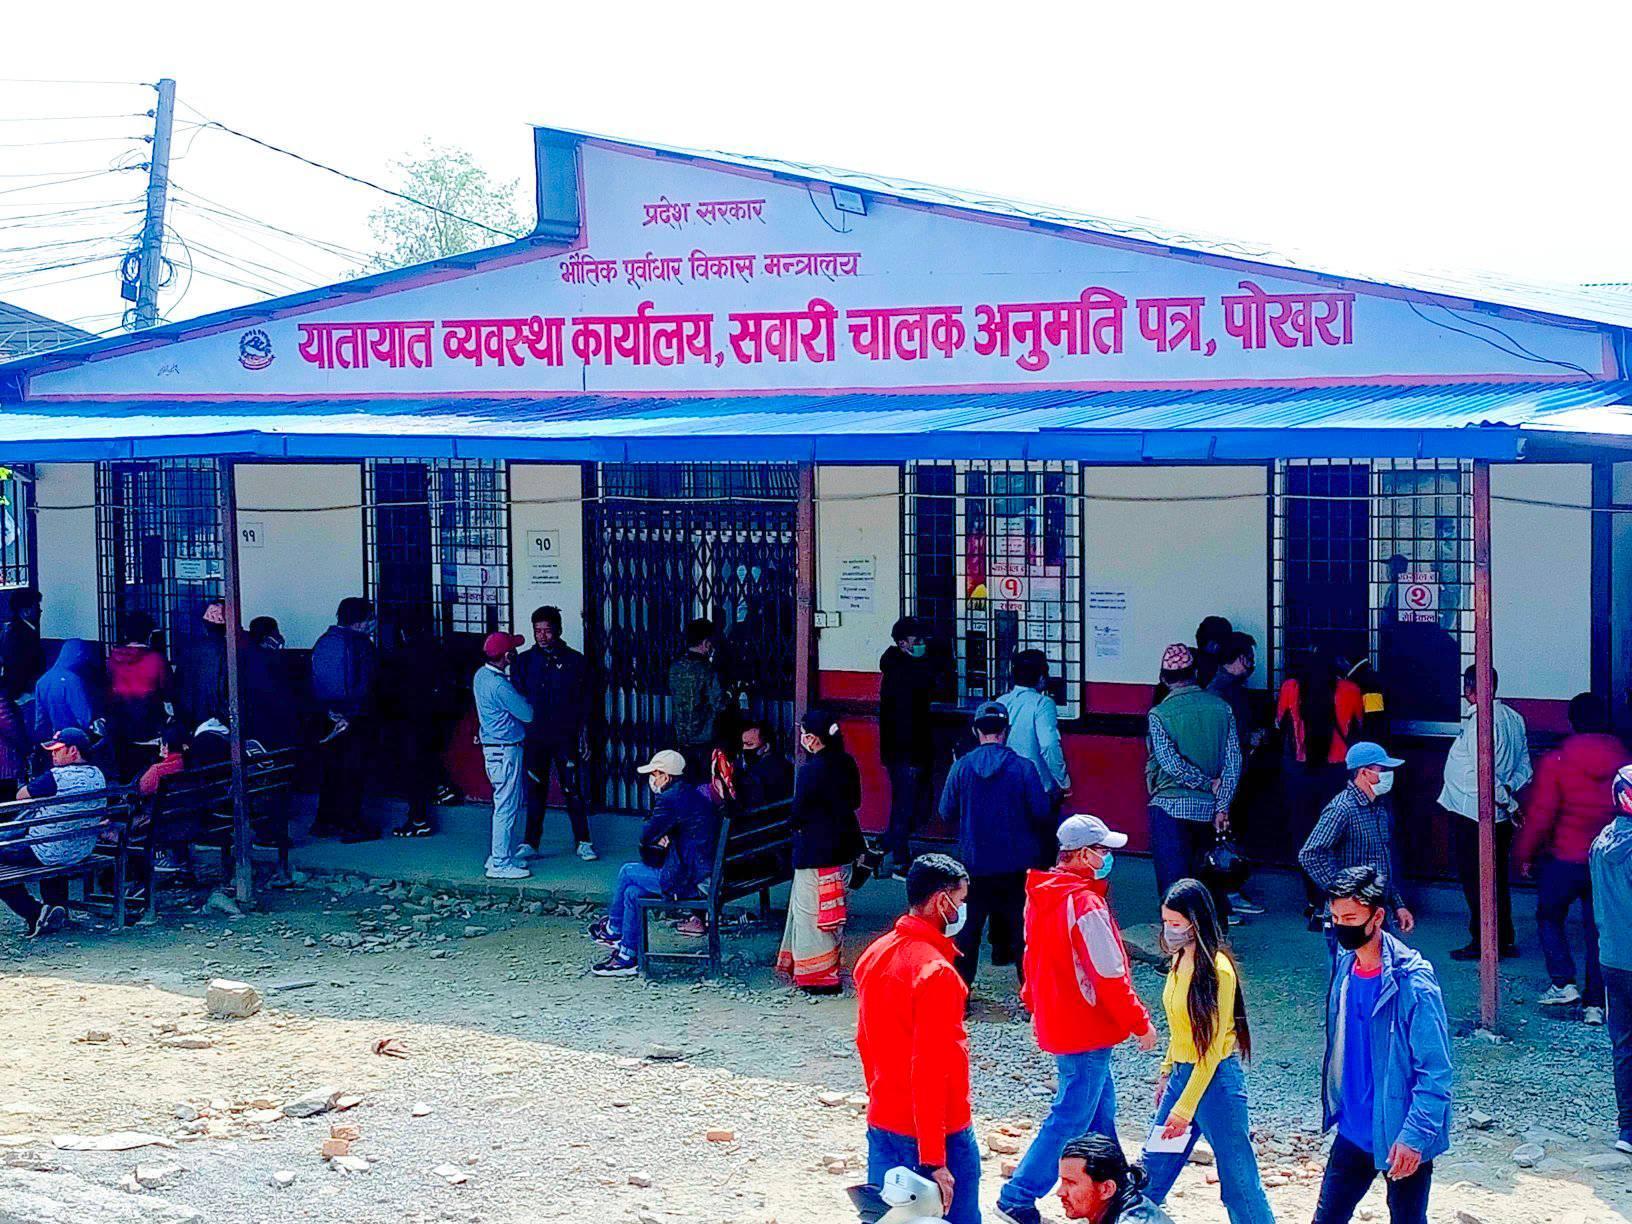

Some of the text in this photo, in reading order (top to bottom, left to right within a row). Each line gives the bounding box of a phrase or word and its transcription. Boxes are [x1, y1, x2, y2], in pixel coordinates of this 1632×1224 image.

[642, 195, 767, 230] प्रदेश सरकार
[559, 249, 862, 290] भौतिक पूर्वाधार विकास मन्त्रालय
[298, 320, 434, 369] यातायात
[442, 315, 565, 367] व्यवस्था
[728, 297, 839, 364] सवारी
[846, 305, 966, 361] चालक
[974, 286, 1127, 372] अनुमति
[1136, 296, 1217, 356] पत्र,
[1221, 280, 1356, 350] पोखरा
